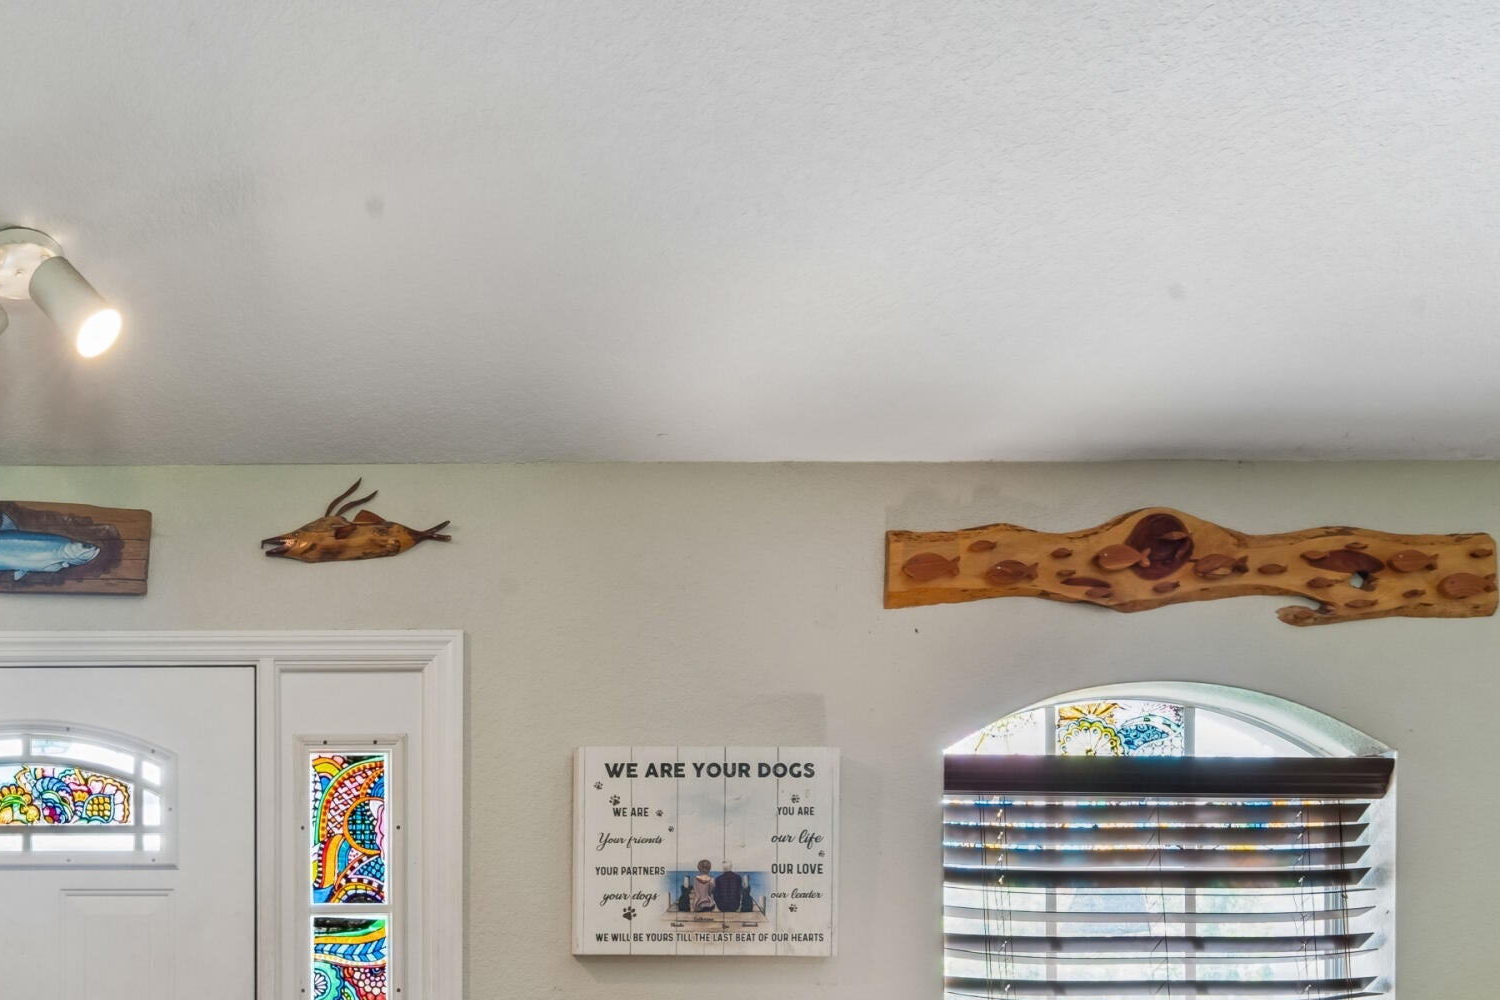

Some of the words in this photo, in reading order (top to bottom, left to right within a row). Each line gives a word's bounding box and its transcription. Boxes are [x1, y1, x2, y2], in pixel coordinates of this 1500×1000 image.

[604, 762, 638, 779] WE
[644, 762, 686, 779] ARE
[692, 762, 751, 779] YOUR
[757, 762, 816, 779] DOGS
[612, 807, 628, 818] WE
[630, 807, 650, 818] ARE
[777, 806, 795, 816] YOU
[797, 806, 815, 816] ARE
[596, 831, 625, 851] Your
[626, 833, 665, 849] friends
[771, 834, 795, 844] our
[798, 829, 824, 850] life
[595, 866, 619, 876] YOUR
[620, 866, 666, 876] PARTNERS
[771, 863, 794, 874] OUR
[796, 863, 824, 874] LOVE
[599, 892, 630, 907] your
[631, 890, 660, 907] dogs
[770, 891, 789, 899] our
[791, 887, 823, 899] leader
[595, 933, 611, 942] WE
[611, 933, 630, 942] WILL
[633, 933, 644, 942] BE
[645, 933, 674, 942] YOURS
[676, 933, 692, 942] TILL
[695, 933, 710, 942] THE
[713, 933, 733, 942] LAST
[735, 933, 756, 942] BEAT
[758, 933, 769, 942] OF
[771, 933, 789, 942] OUR
[791, 933, 824, 942] HEARTS
